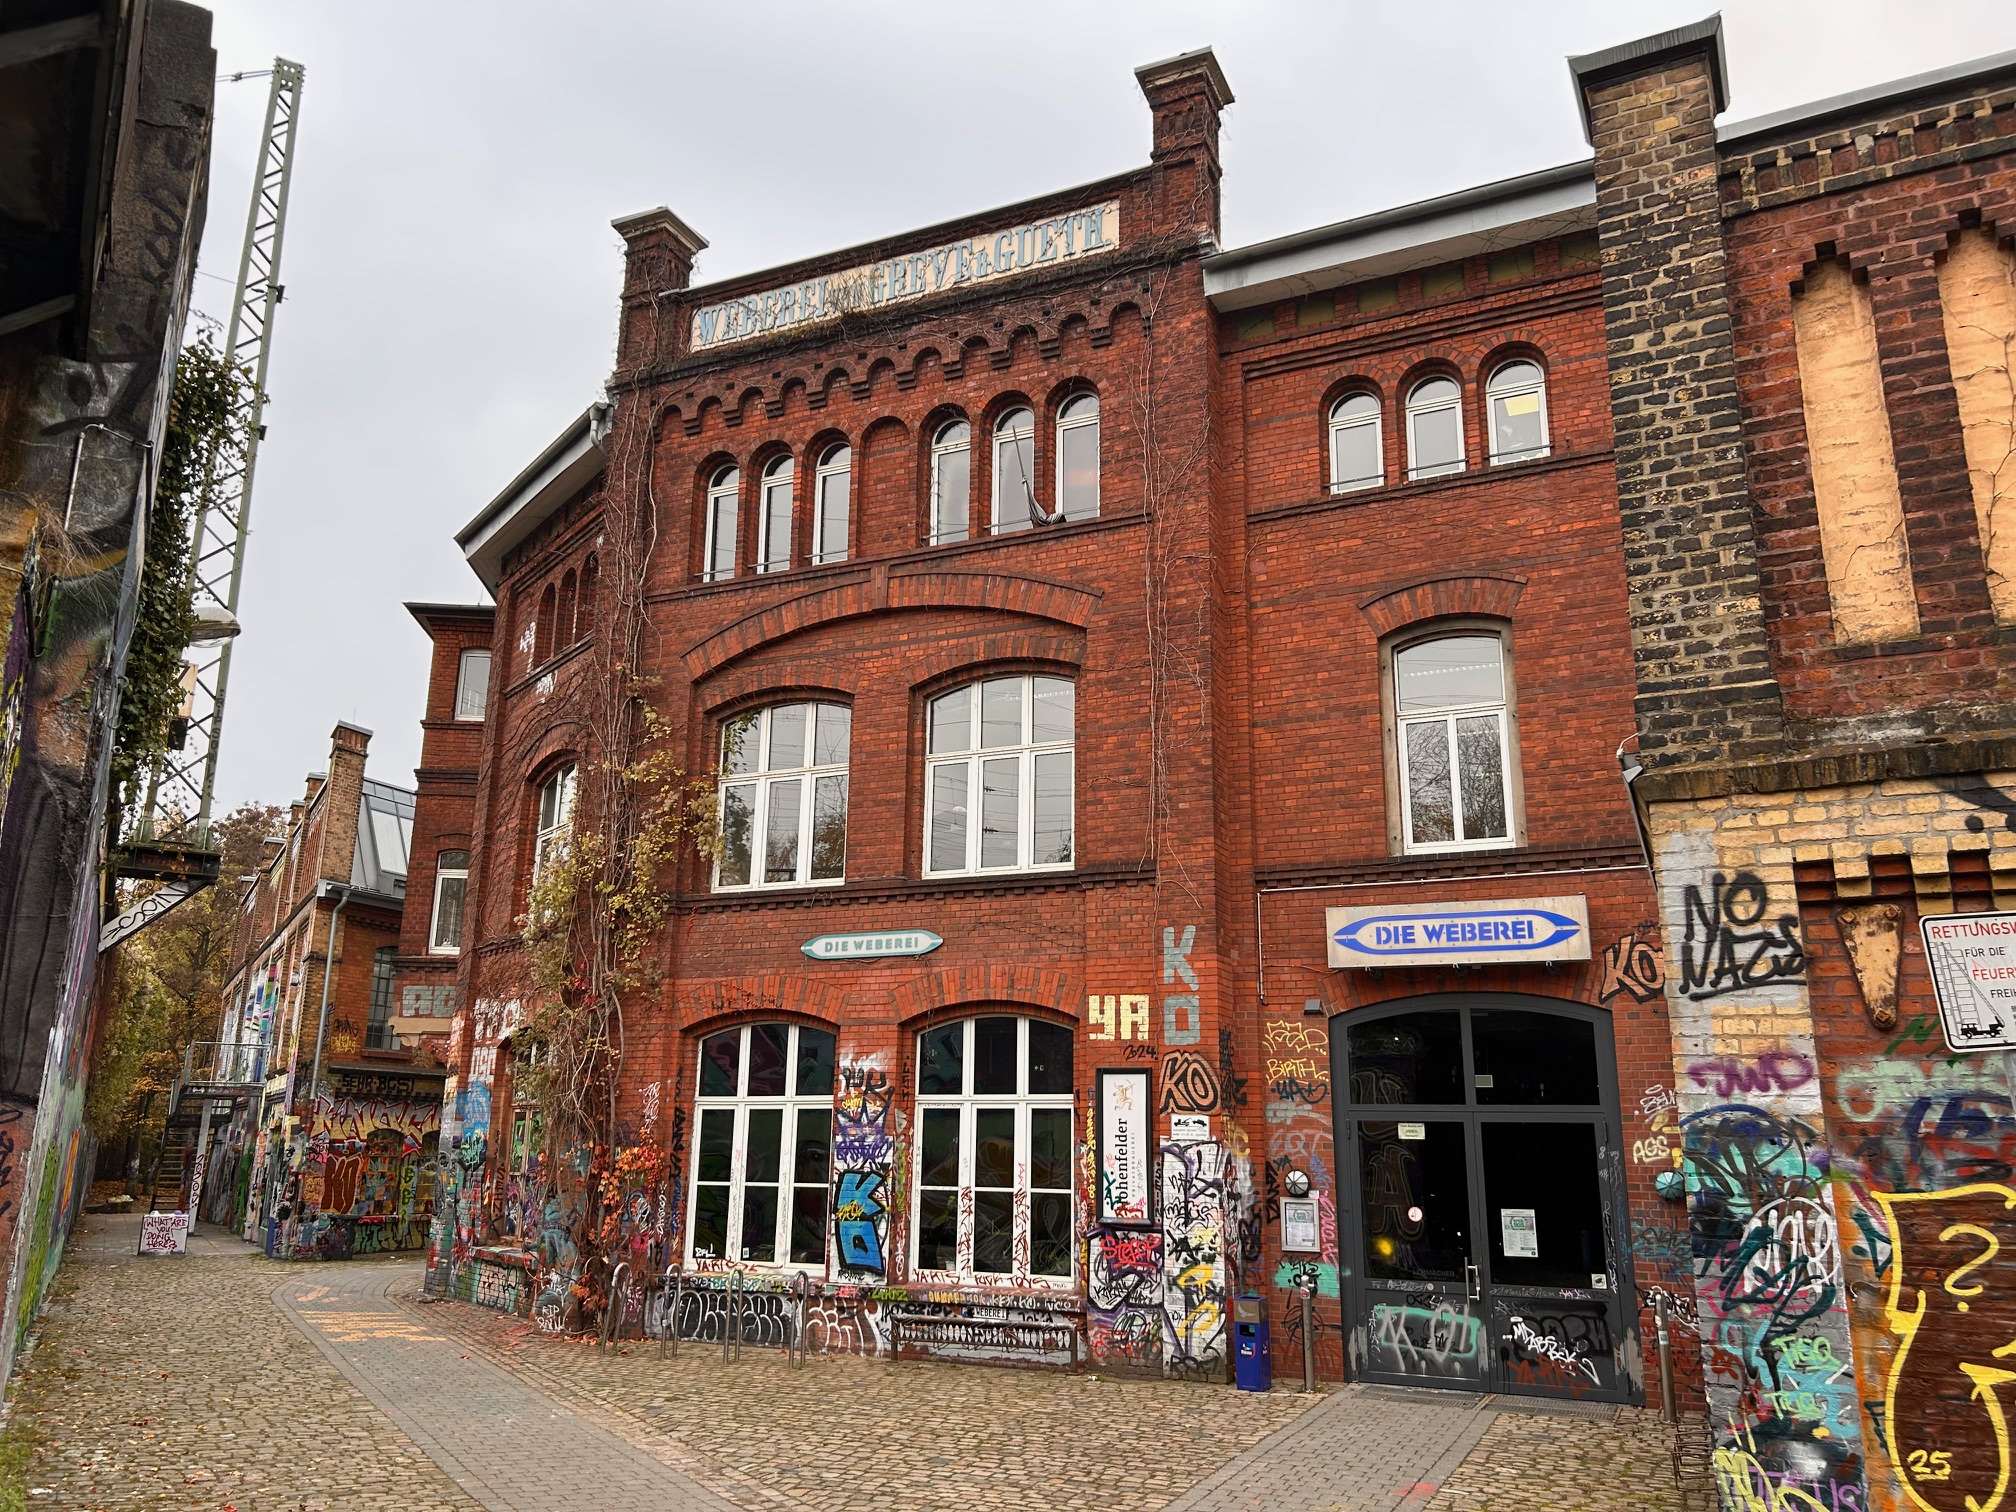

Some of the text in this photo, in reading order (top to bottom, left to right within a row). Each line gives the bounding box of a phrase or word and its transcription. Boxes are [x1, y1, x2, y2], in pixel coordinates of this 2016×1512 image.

[698, 279, 829, 346] WEBEREI
[1684, 870, 1768, 941] NO
[1375, 920, 1534, 945] DIE WEBEREI
[824, 937, 919, 953] DIE WEBEREI
[1965, 947, 2006, 958] FÜR DIE
[1972, 967, 2016, 981] FEUER
[147, 1217, 187, 1227] WHAT ARE
[1907, 1449, 1952, 1477] 25
